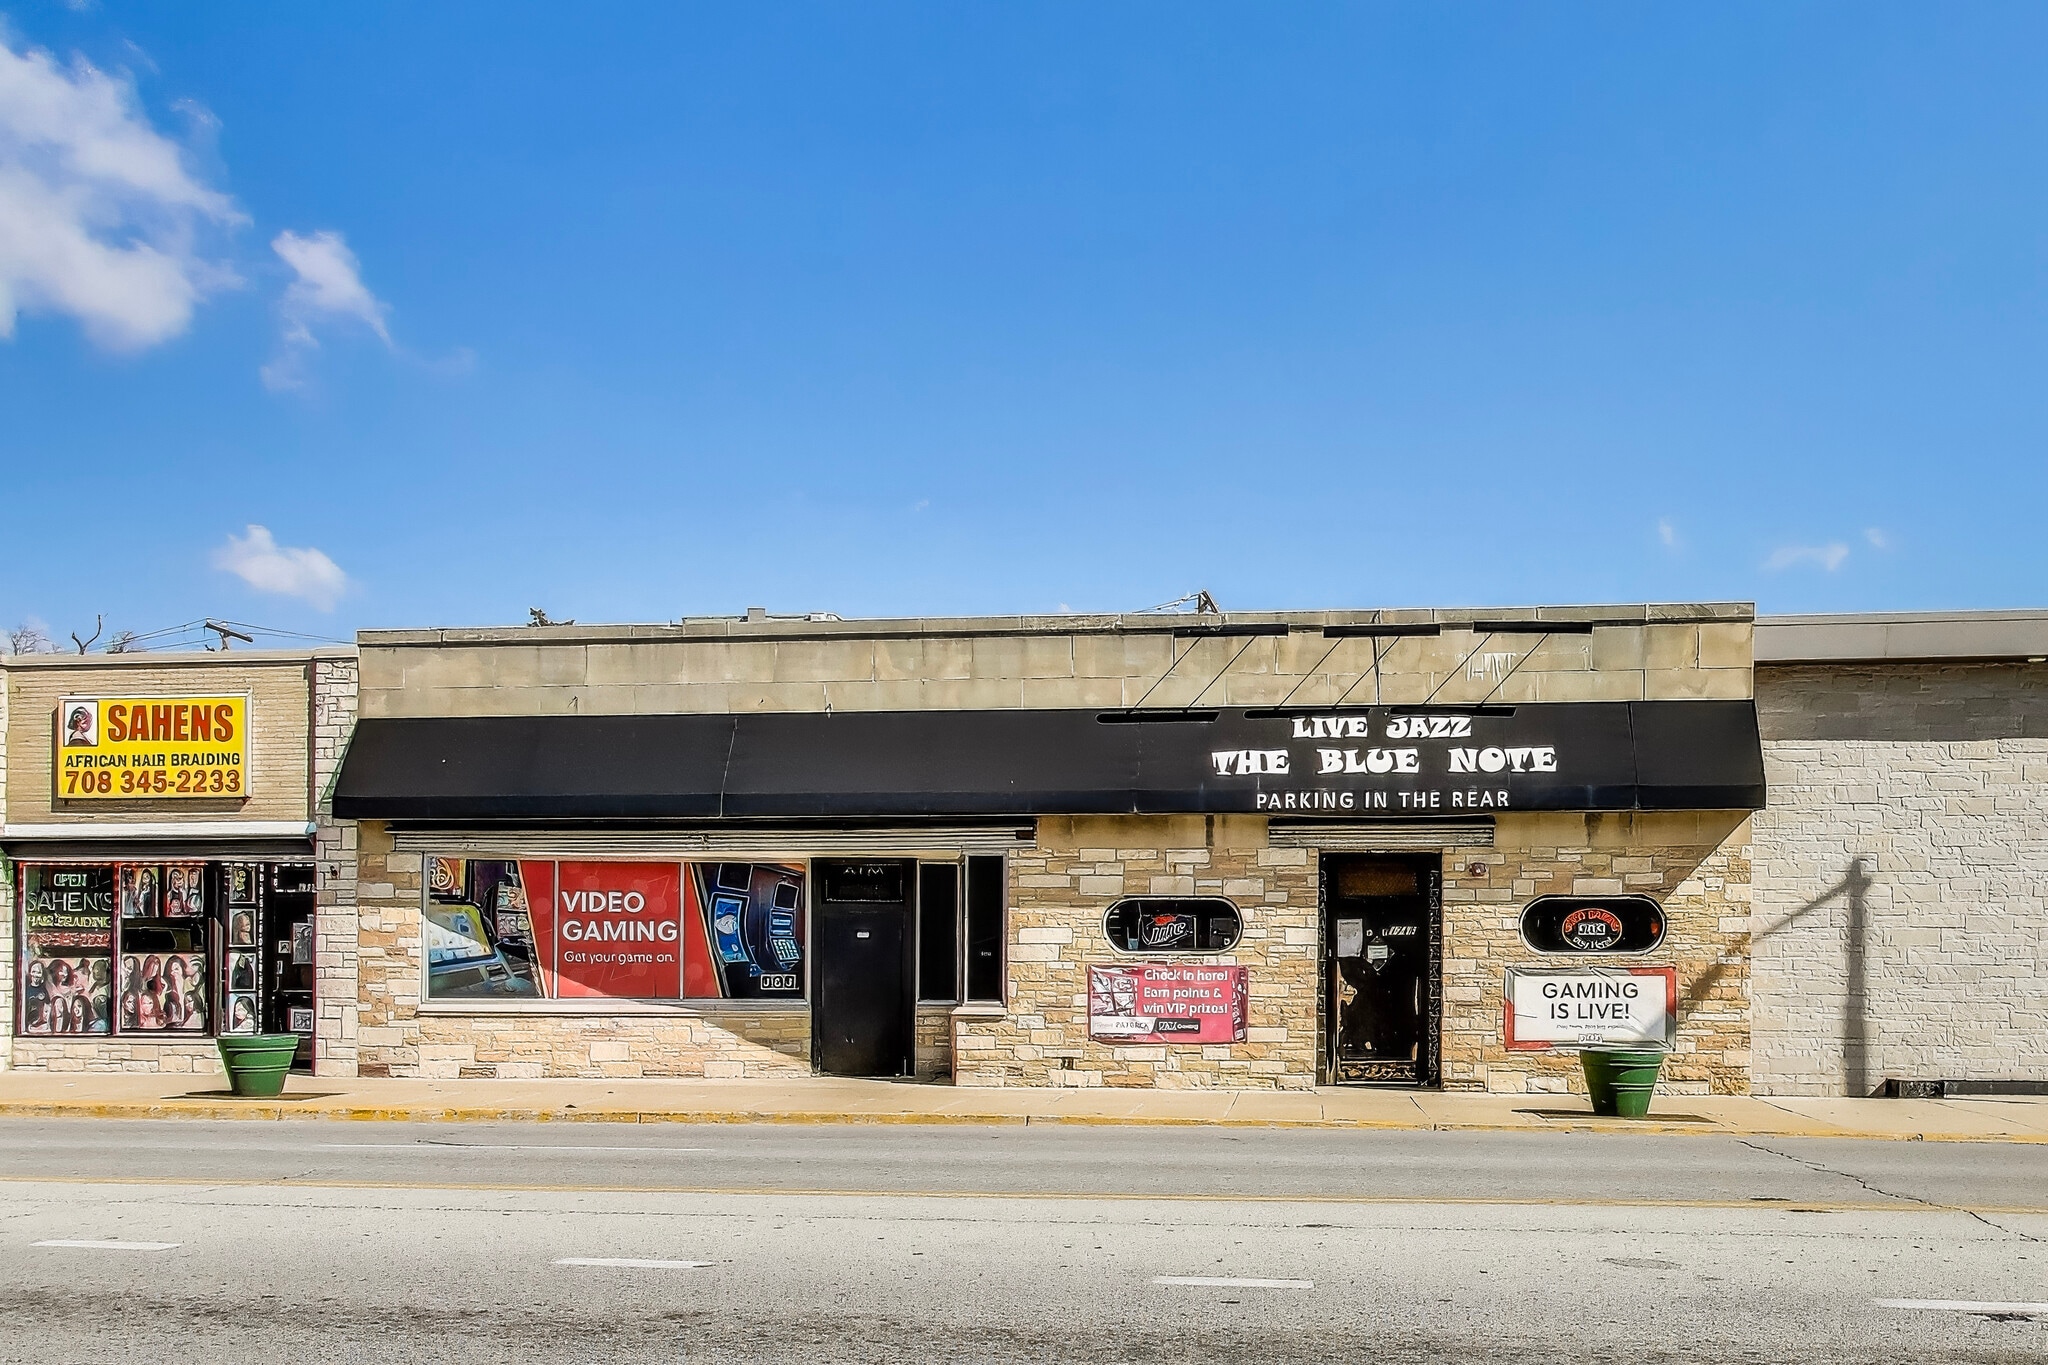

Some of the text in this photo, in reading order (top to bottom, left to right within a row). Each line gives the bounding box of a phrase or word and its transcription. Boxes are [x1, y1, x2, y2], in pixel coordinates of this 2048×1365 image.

[108, 704, 234, 742] SAHENS
[1291, 716, 1472, 739] LIVE JAZZ
[65, 753, 241, 768] AFRICAN HAIR BRAIDING
[1211, 747, 1557, 776] THE BLUE NOTE
[65, 769, 241, 794] 708 345-2233
[1256, 790, 1509, 809] PARKING IN THE REAR
[561, 891, 645, 913] VIDEO
[562, 920, 678, 942] GAMING
[564, 950, 586, 963] Get
[589, 953, 616, 965] your
[618, 953, 653, 965] game
[1144, 968, 1180, 981] Check
[1197, 969, 1228, 981] here!
[1143, 987, 1222, 1000] Earn points &
[1542, 982, 1639, 999] GAMING
[1143, 1003, 1228, 1017] win VIP prizes!
[1550, 1003, 1630, 1020] IS LIVE!
